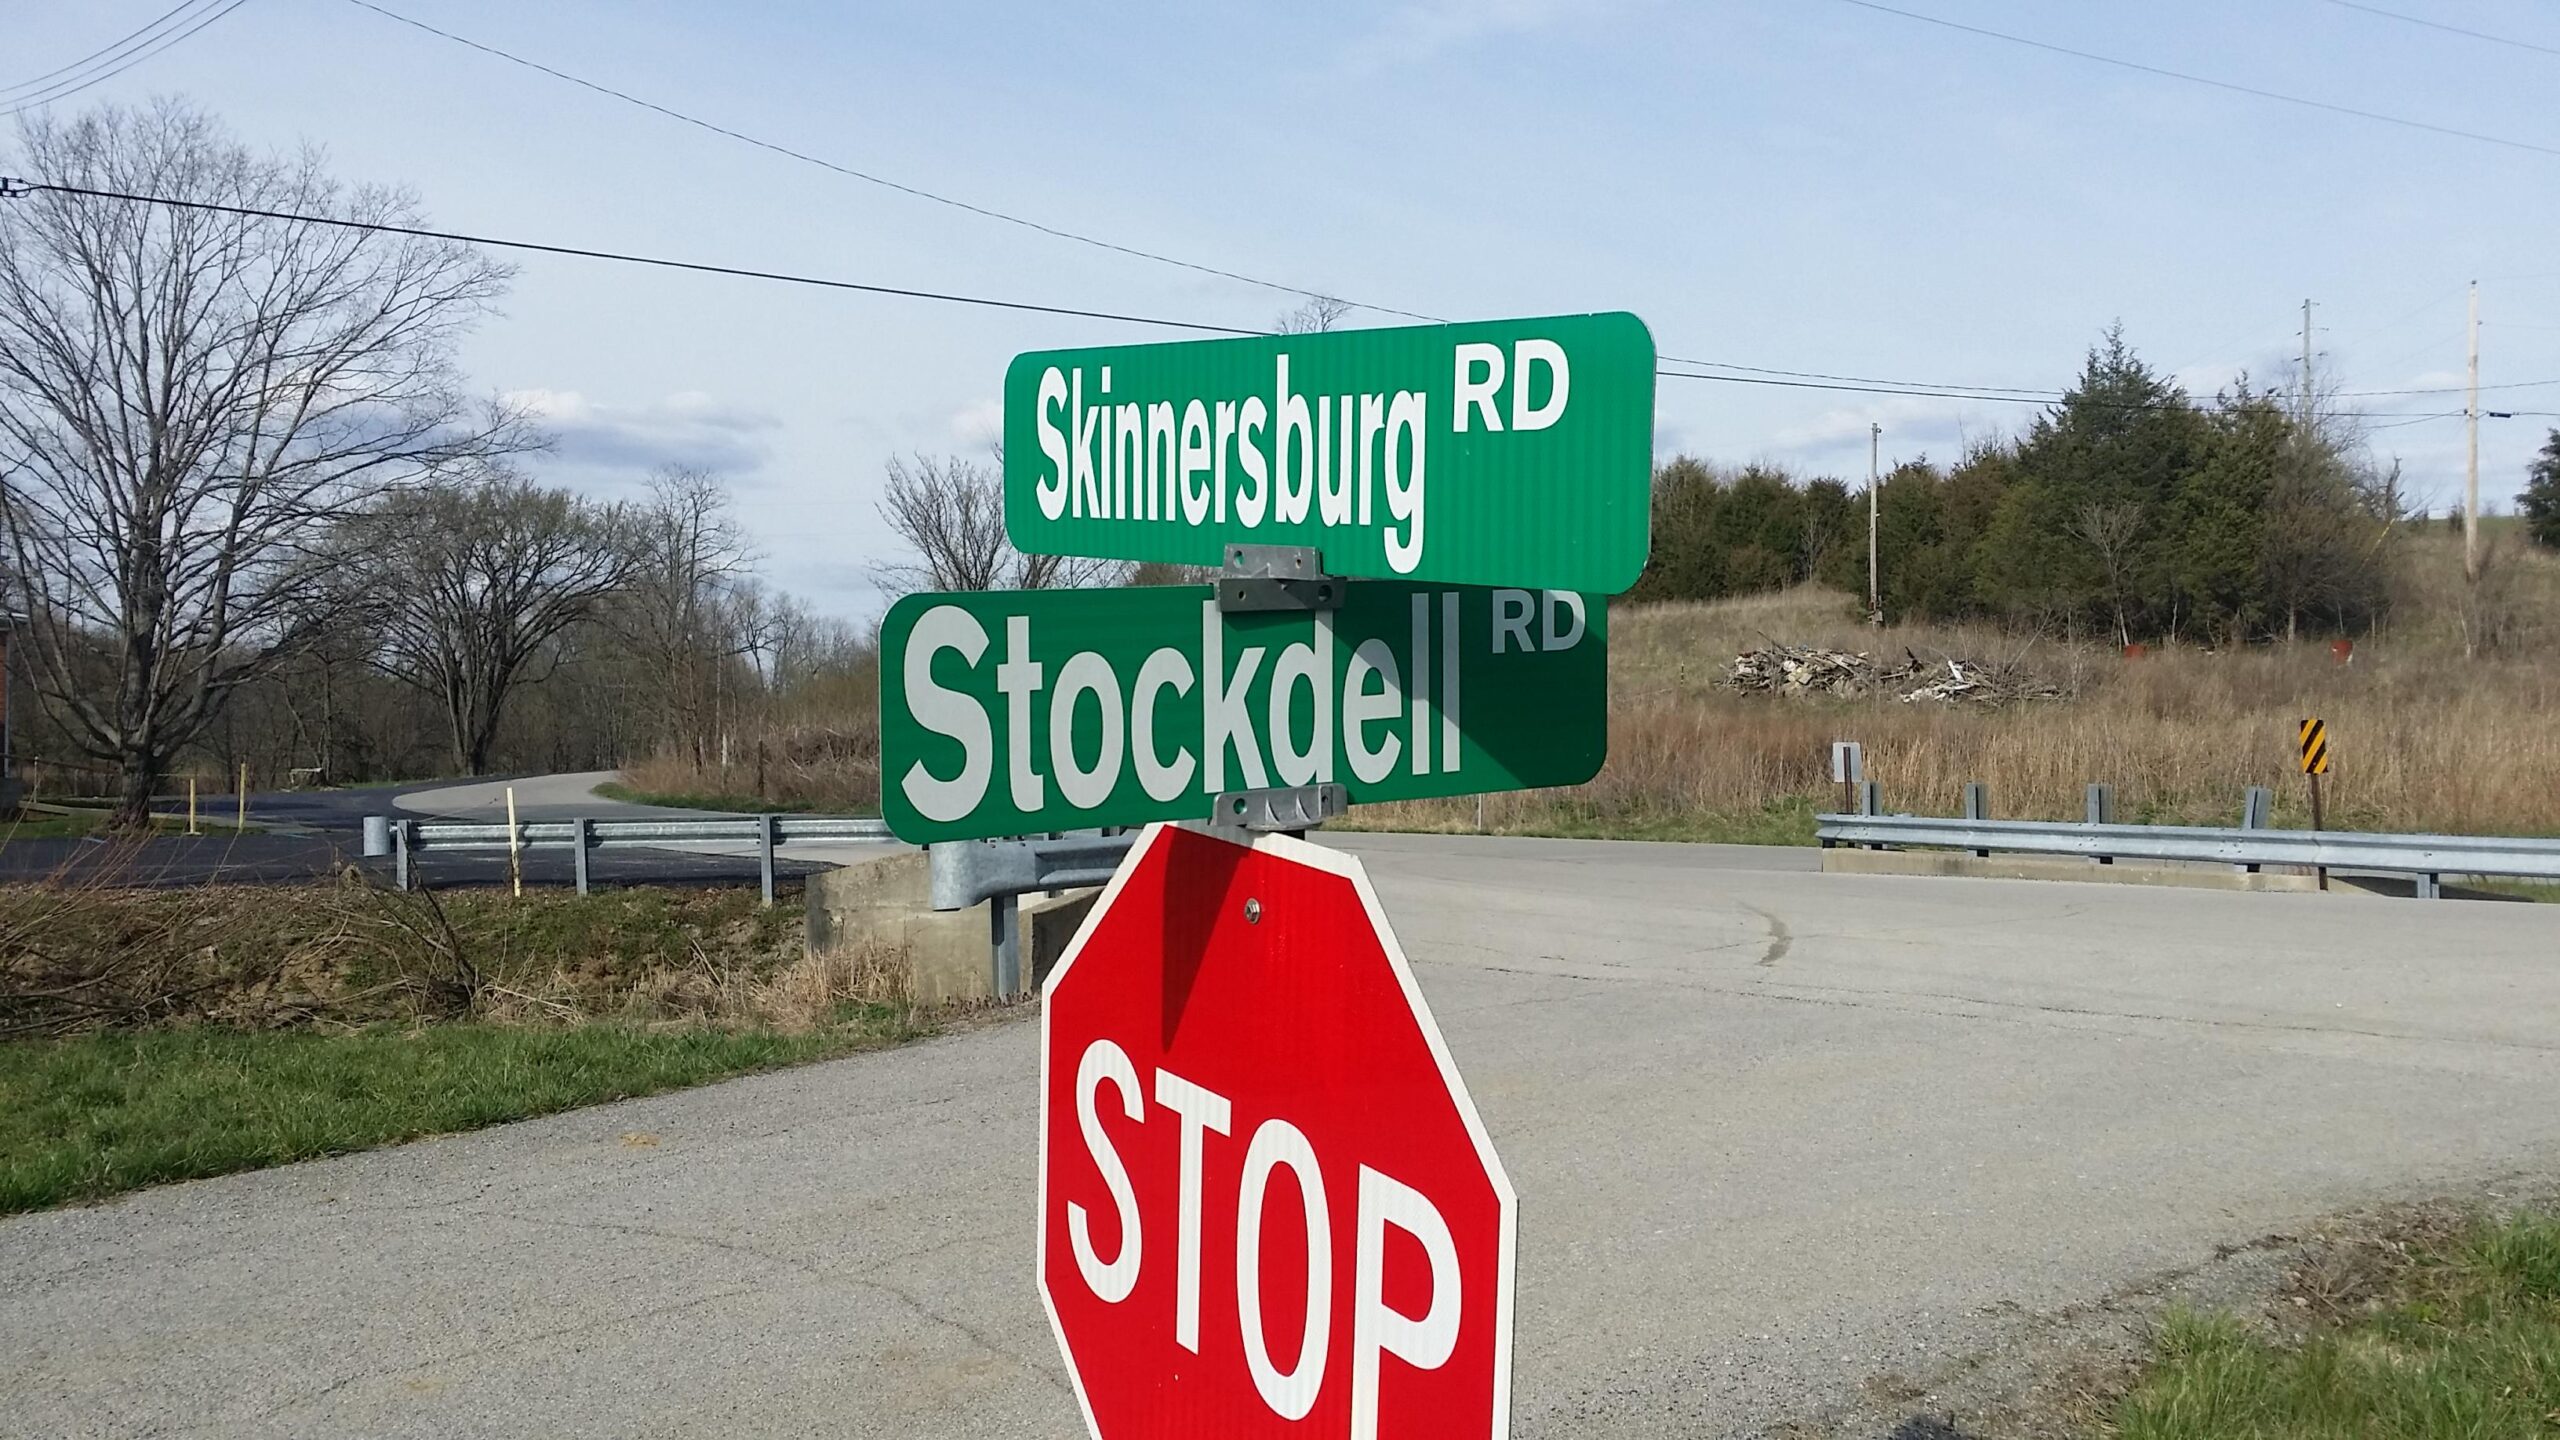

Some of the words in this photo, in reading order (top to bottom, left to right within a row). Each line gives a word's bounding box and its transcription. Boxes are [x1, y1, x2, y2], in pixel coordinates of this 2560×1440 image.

[1036, 354, 1426, 573] Skinnersburg
[1453, 338, 1571, 432] RD
[901, 592, 1460, 823] Stockdell
[1491, 589, 1585, 654] RD
[1067, 1039, 1462, 1440] STOP
